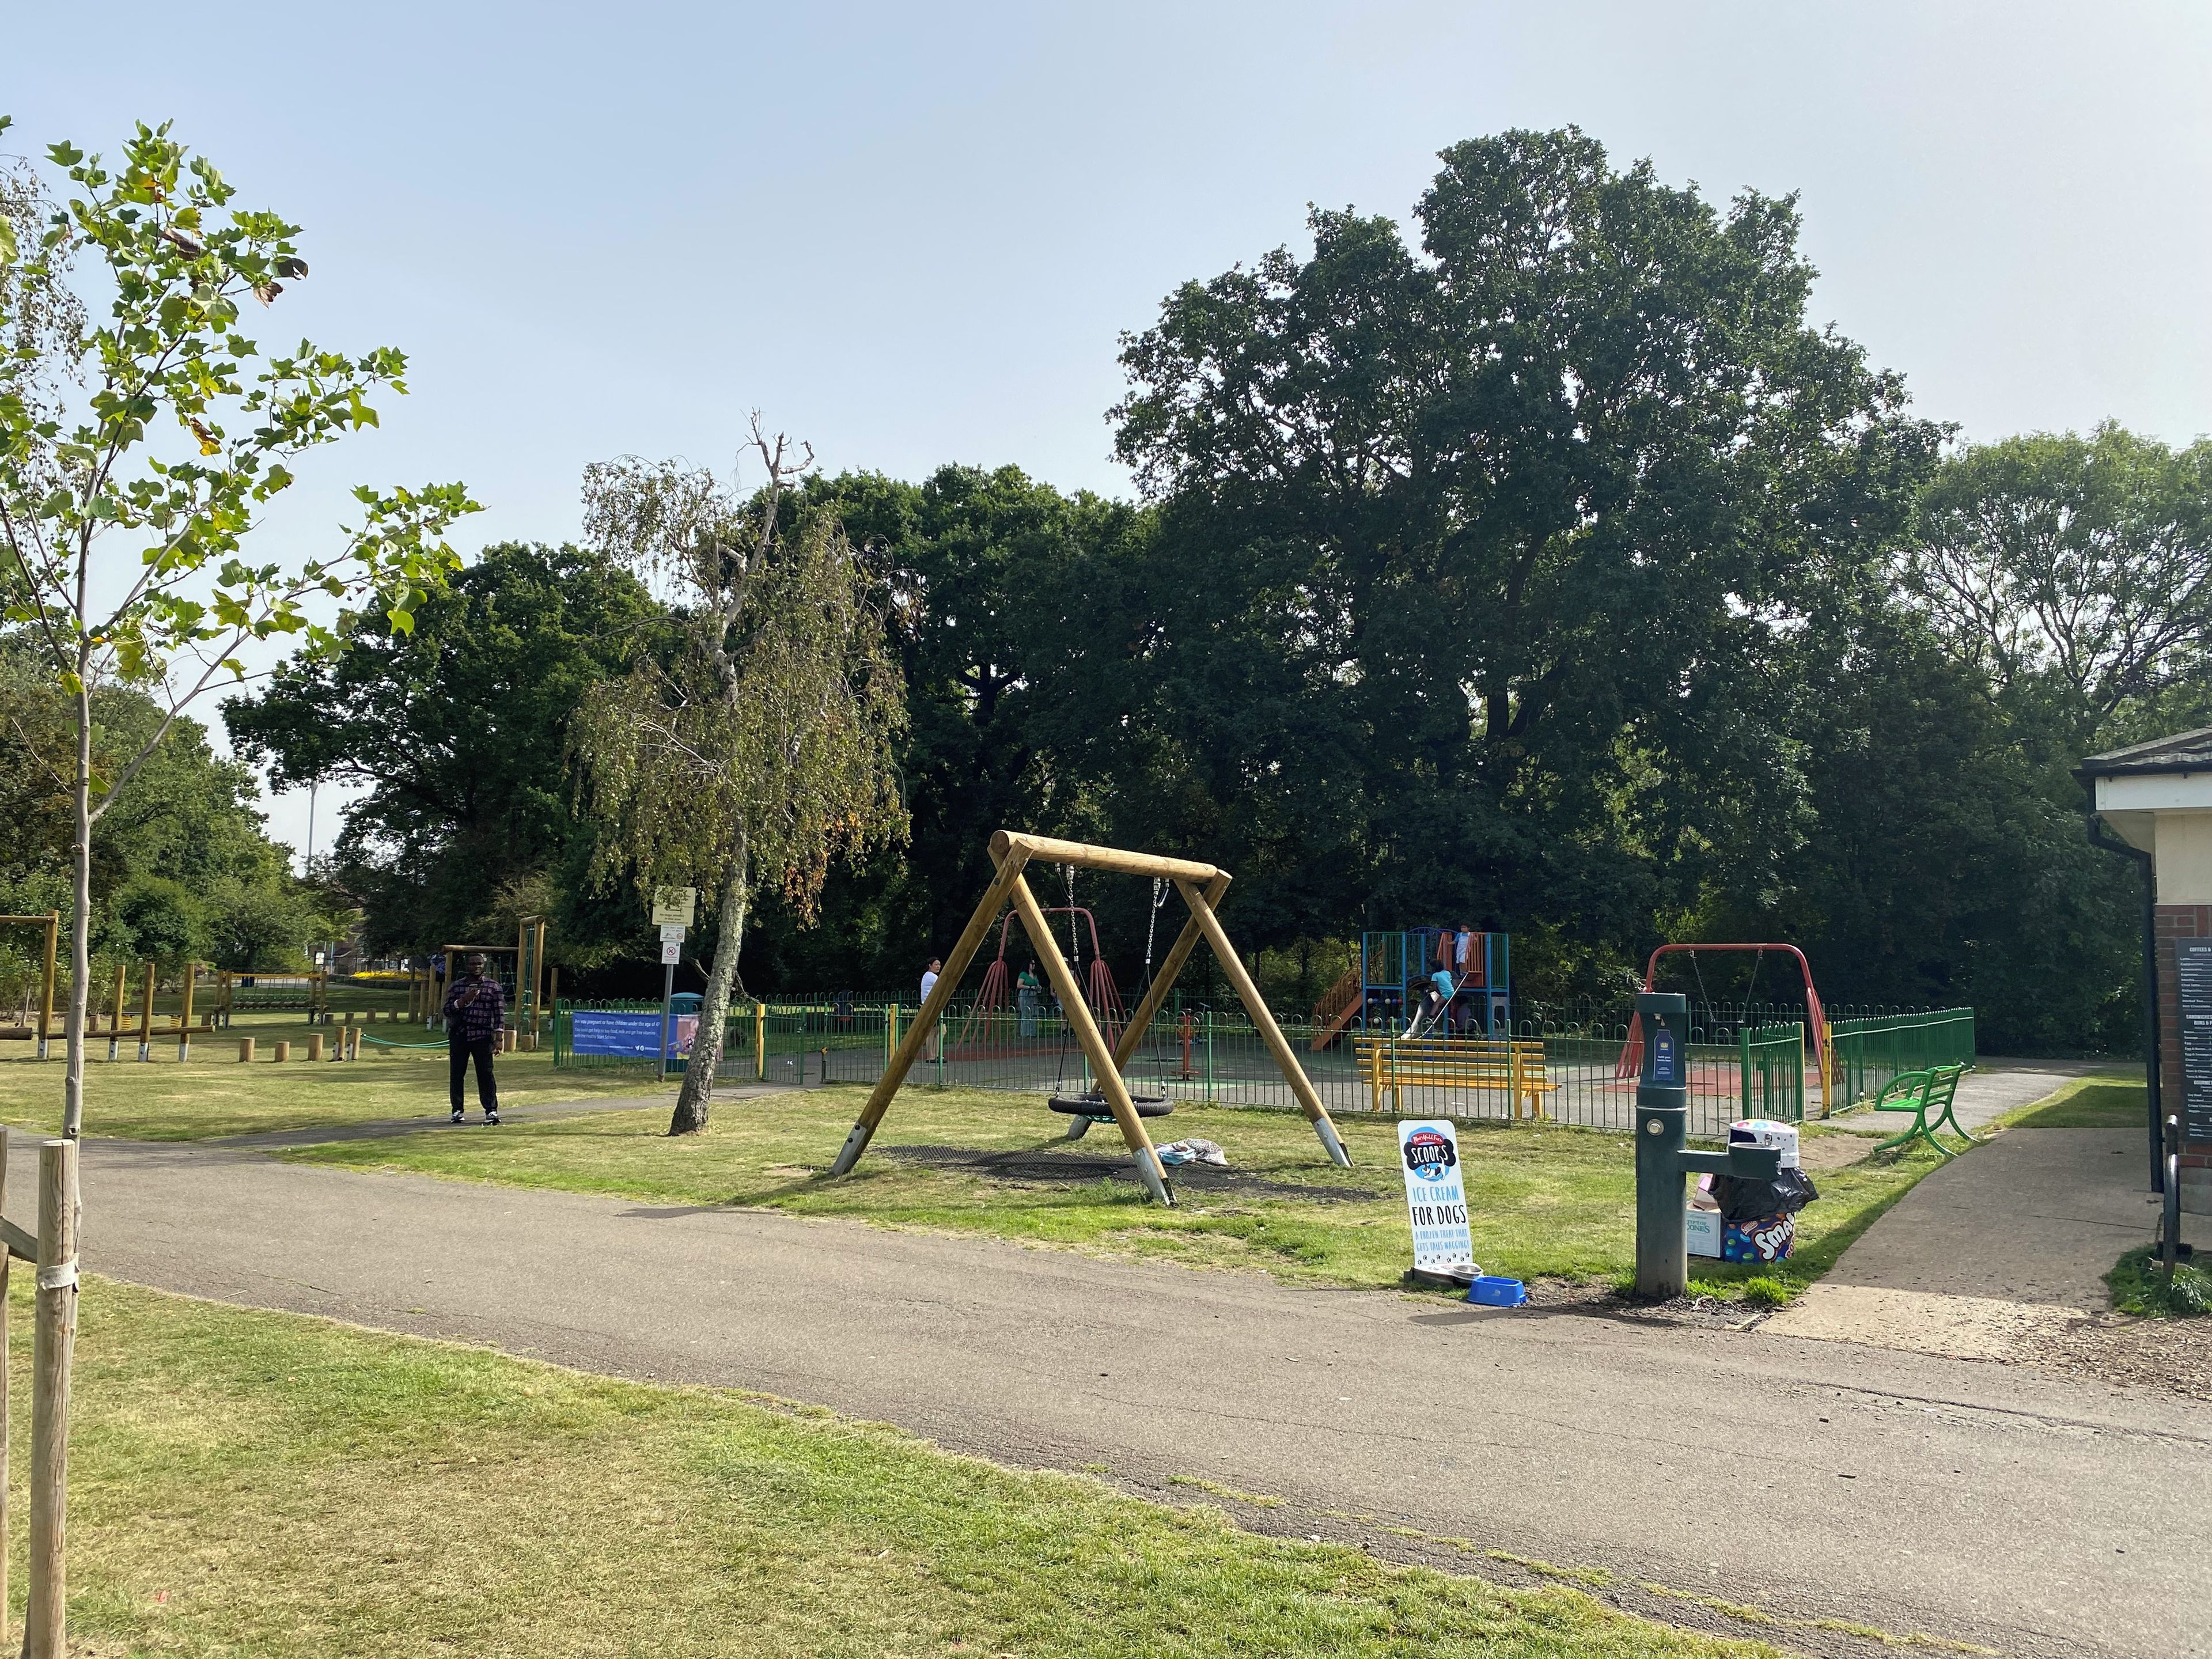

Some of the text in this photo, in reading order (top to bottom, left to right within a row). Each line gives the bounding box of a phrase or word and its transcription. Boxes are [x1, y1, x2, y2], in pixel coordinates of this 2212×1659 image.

[1411, 1145, 1448, 1163] SCOOP'S
[1412, 1185, 1459, 1202] ICE CREAM
[1412, 1205, 1466, 1226] FOR DOGS
[1415, 1229, 1467, 1240] A FROZEN TREAT THAT
[1416, 1240, 1469, 1252] GETS TAILS WAGGING!
